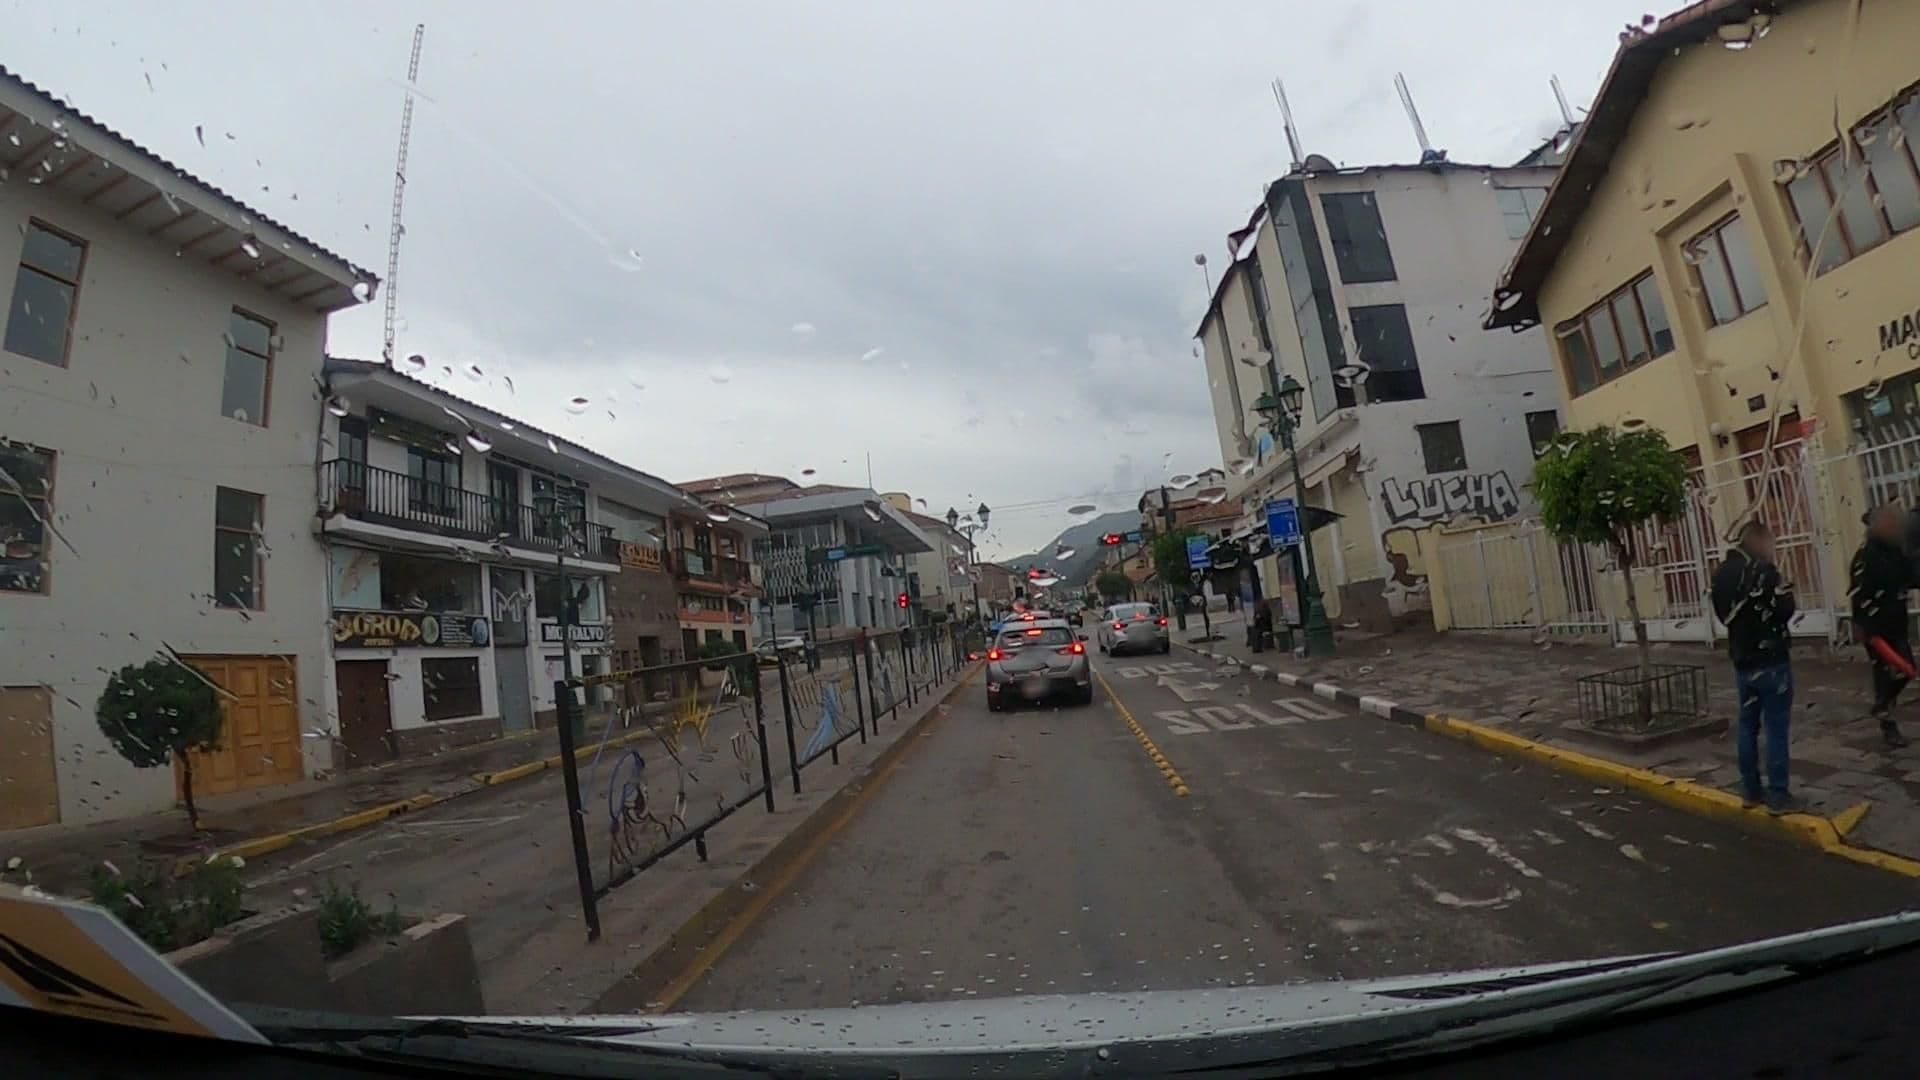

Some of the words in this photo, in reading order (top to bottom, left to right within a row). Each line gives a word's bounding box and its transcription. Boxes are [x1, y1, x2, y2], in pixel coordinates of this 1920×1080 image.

[1879, 309, 1920, 351] MA
[1381, 470, 1519, 524] LUCHA
[1153, 698, 1348, 735] SOLO
